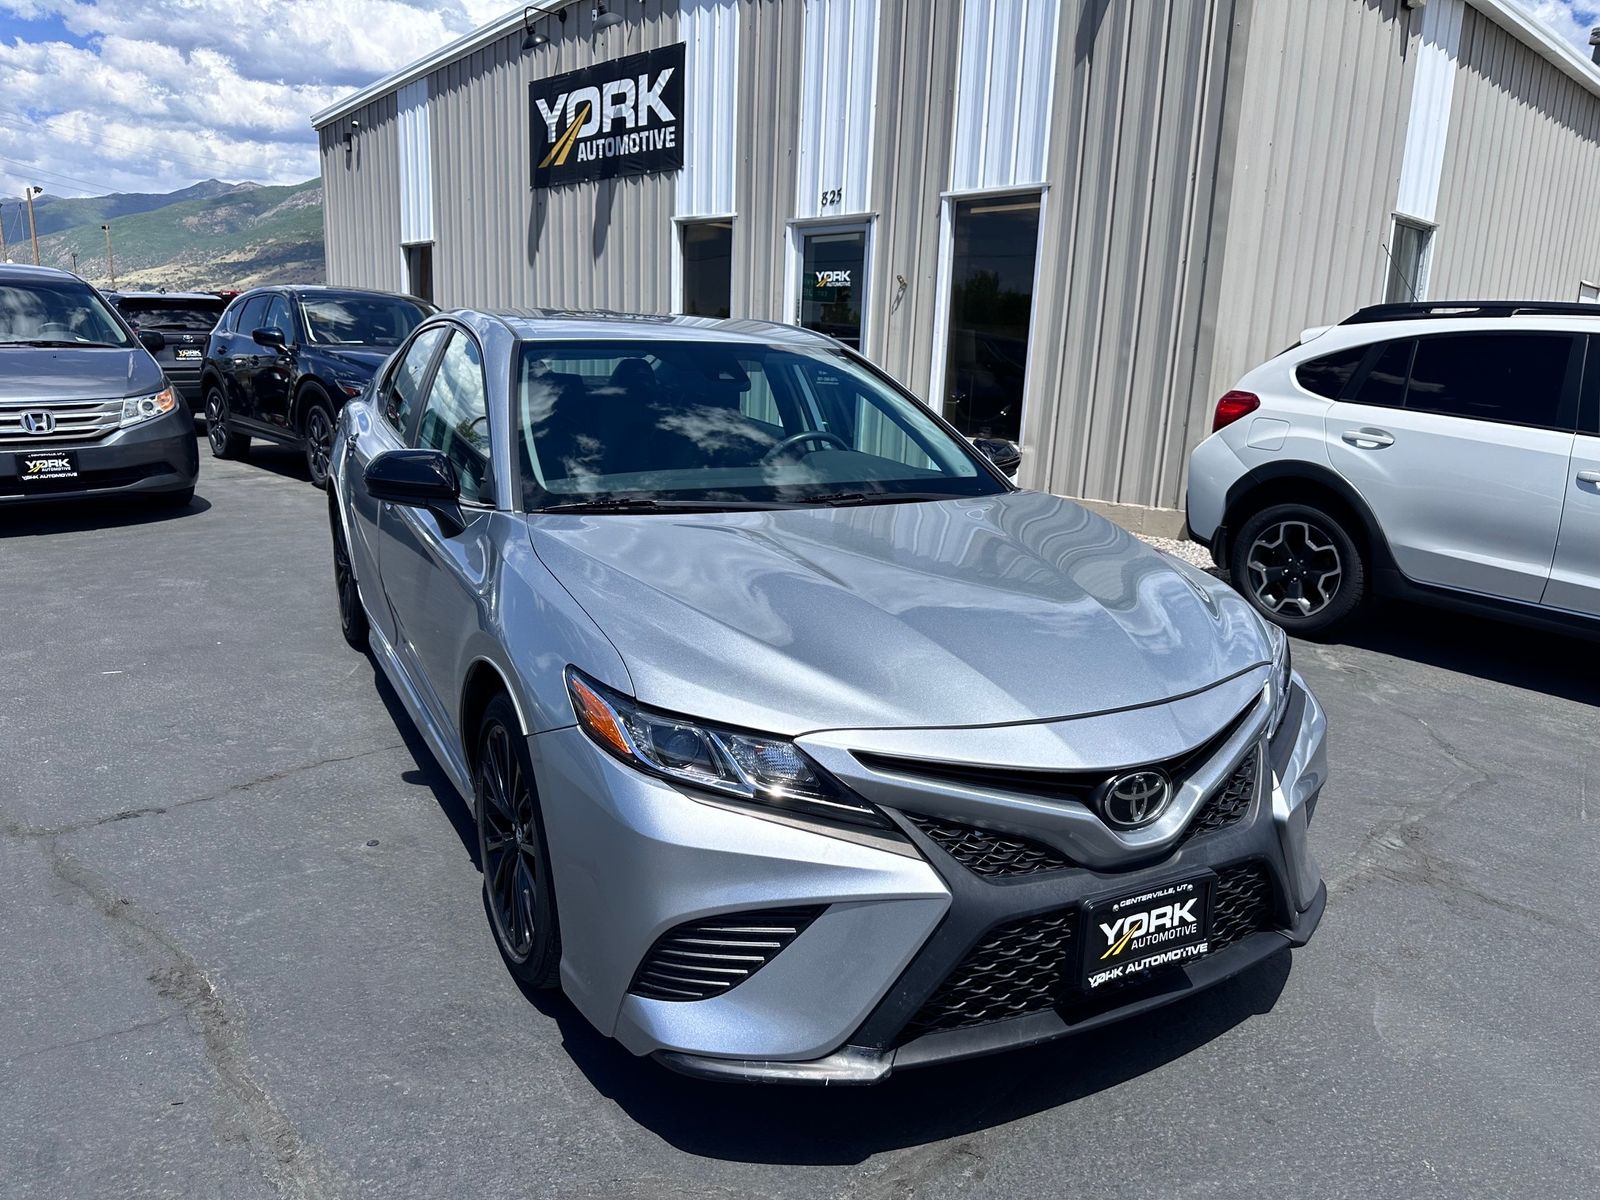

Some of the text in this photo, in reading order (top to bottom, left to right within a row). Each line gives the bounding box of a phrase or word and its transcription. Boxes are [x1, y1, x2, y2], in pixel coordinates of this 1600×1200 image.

[535, 67, 676, 143] YORK
[577, 126, 676, 162] AUTOMOTIVE
[821, 187, 842, 207] 825
[816, 270, 851, 282] YORK
[25, 458, 70, 469] YORK
[1119, 883, 1188, 907] CENTERVILLE, UT
[1099, 897, 1198, 946] YORK
[1131, 923, 1197, 950] AUTOMOTIVE
[1125, 942, 1208, 975] AUTOMOTIVE
